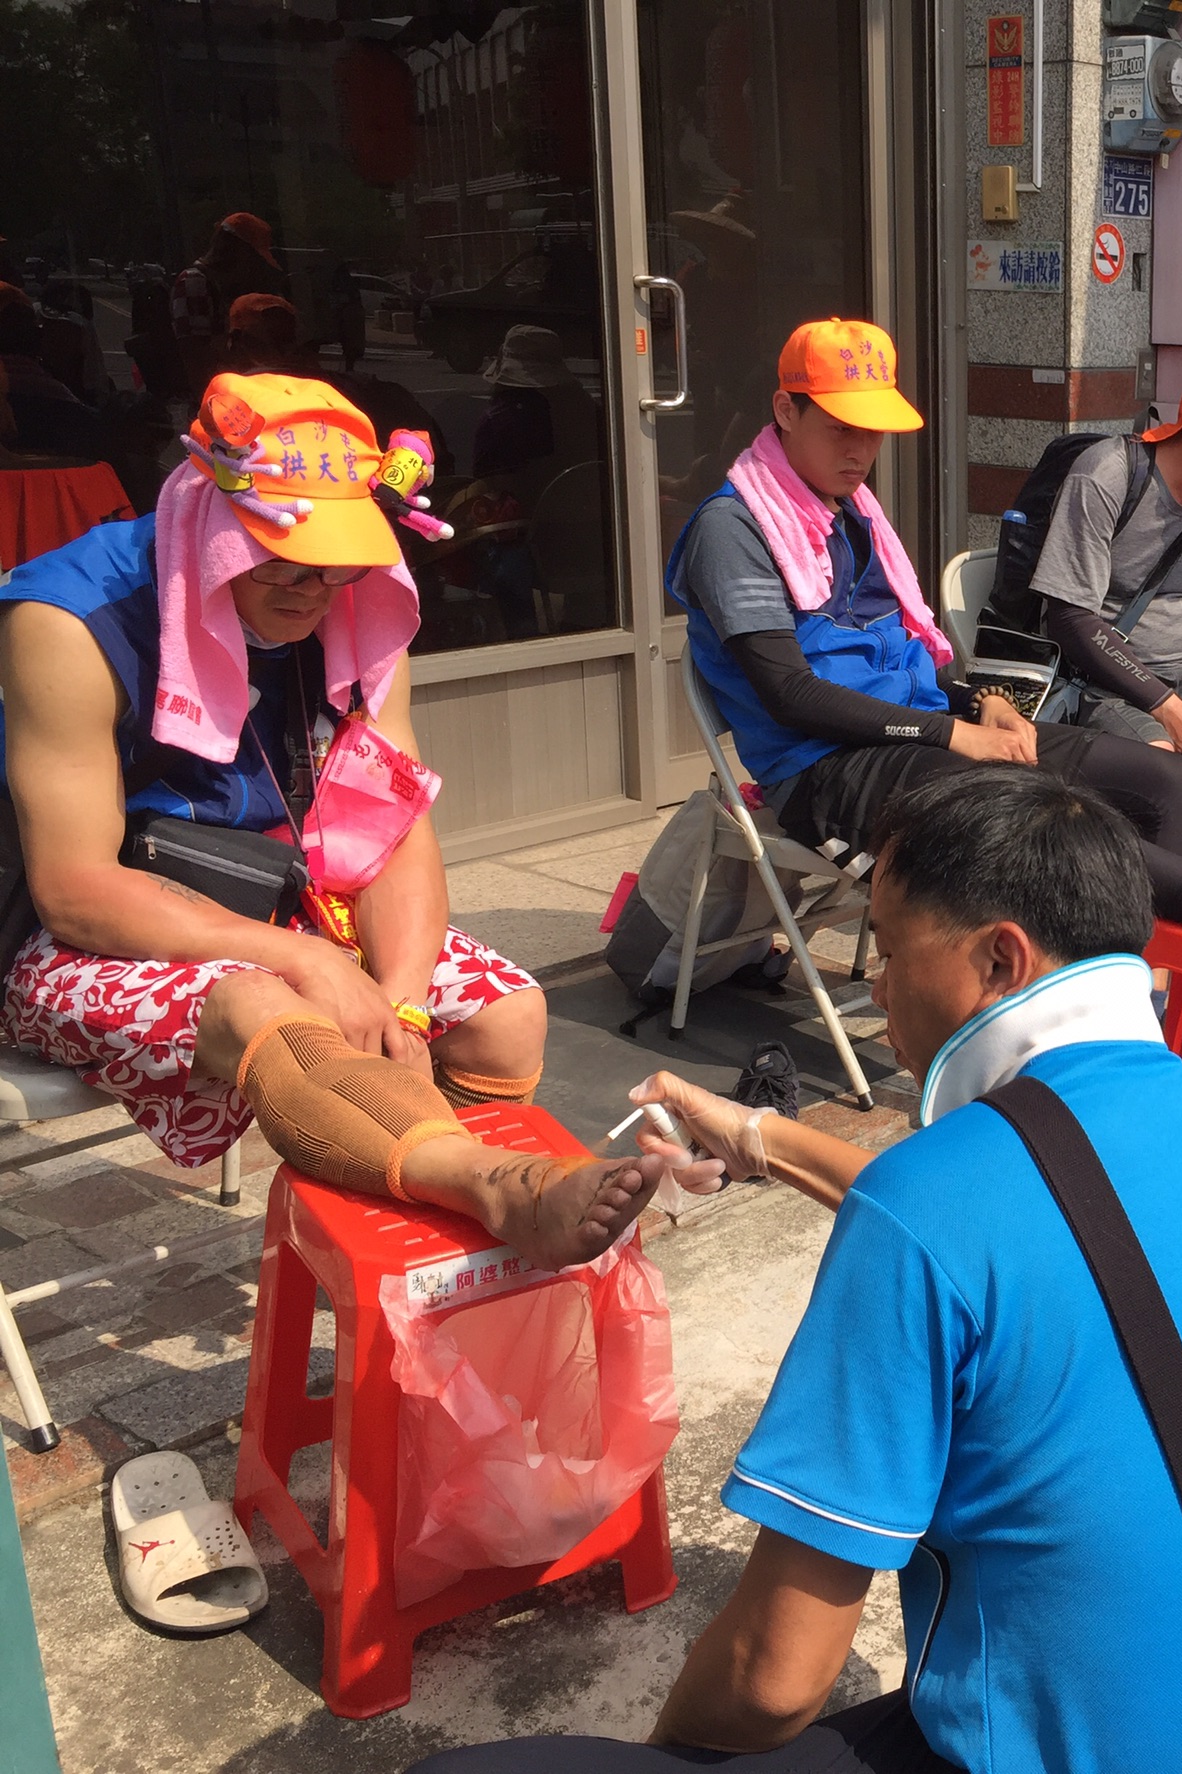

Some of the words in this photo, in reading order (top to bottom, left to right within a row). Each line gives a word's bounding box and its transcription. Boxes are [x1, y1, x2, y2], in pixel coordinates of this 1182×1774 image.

[1115, 180, 1149, 216] 275
[999, 249, 1060, 285] 來訪請按鈴
[280, 450, 359, 482] 拱天宮
[1105, 645, 1151, 682] LIFESTYLE
[885, 725, 922, 737] SUCCESS
